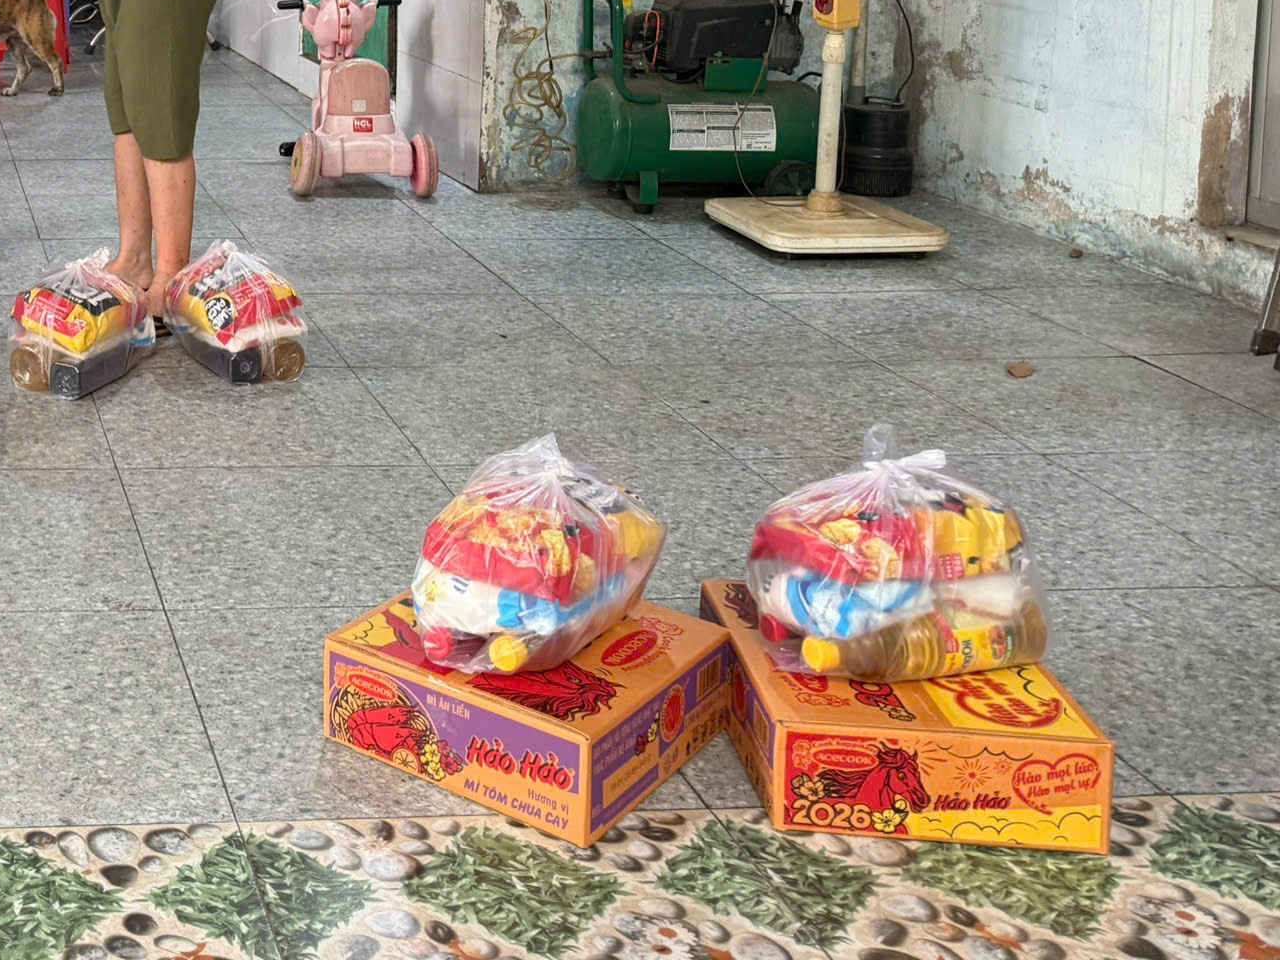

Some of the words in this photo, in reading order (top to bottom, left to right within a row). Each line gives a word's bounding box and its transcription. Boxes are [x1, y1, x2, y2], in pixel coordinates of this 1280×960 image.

[465, 735, 517, 775] Hảo
[518, 749, 574, 790] Hảo
[463, 777, 480, 793] MÌ
[482, 784, 508, 806] TÔM
[511, 798, 542, 820] CHUA
[545, 812, 569, 830] CAY
[791, 798, 873, 830] 2026
[933, 791, 971, 812] Hảo
[972, 790, 1012, 811] Hảo
